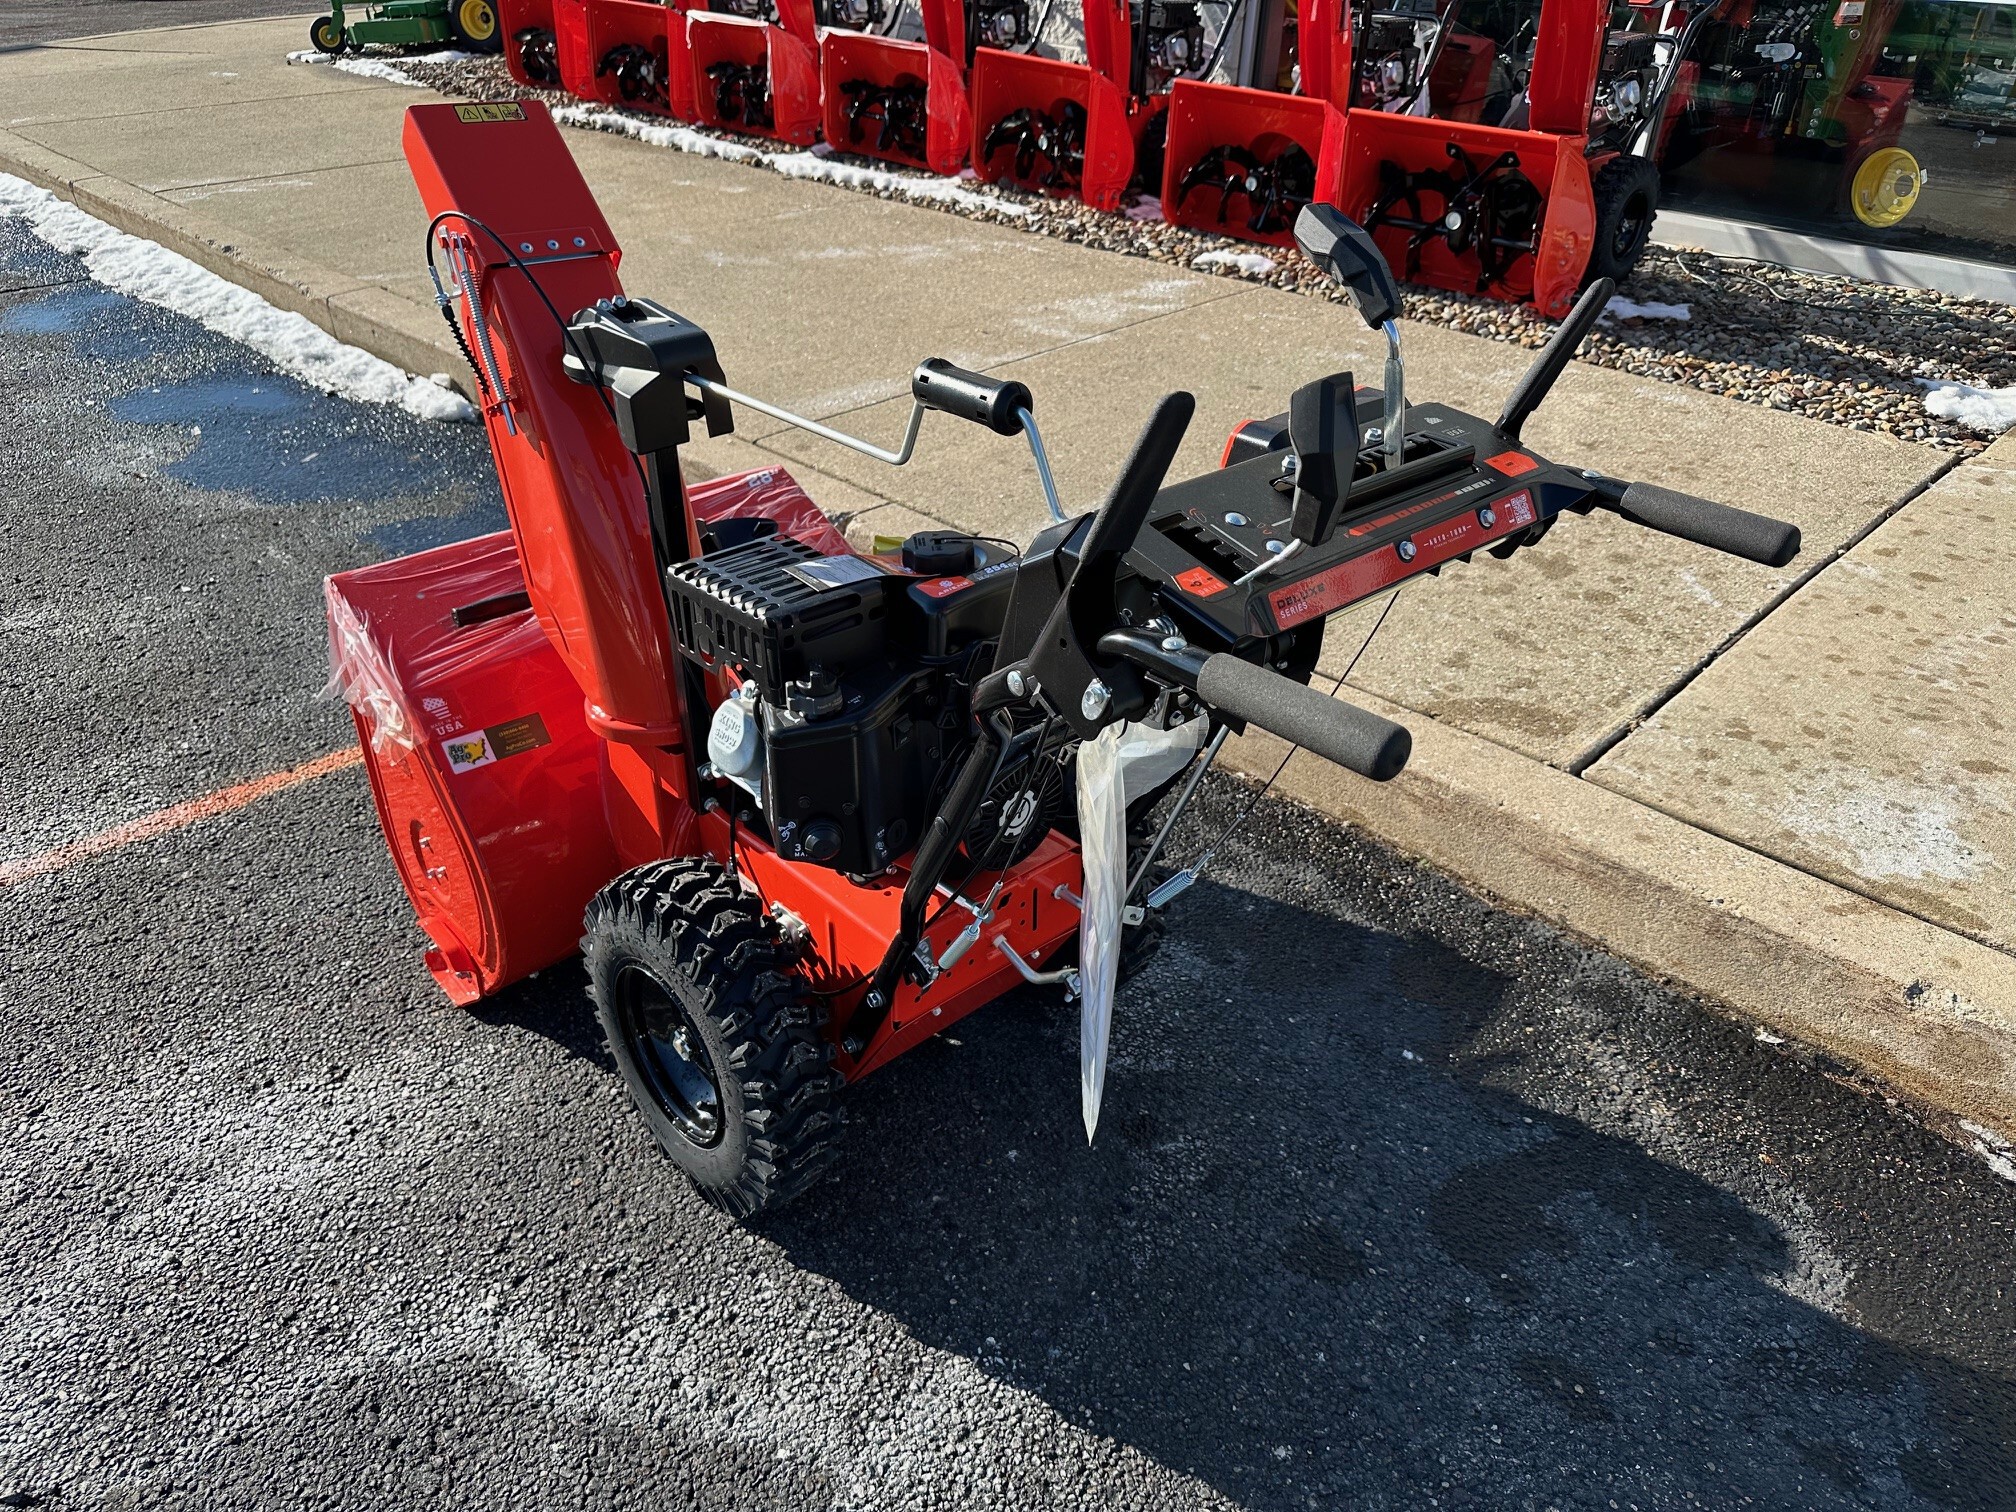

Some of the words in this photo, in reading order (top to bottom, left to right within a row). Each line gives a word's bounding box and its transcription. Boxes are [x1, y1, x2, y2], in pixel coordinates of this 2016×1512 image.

[938, 581, 970, 596] ARIENS
[1197, 582, 1223, 596] DRIVE
[1276, 582, 1325, 610] DELUXE
[1280, 602, 1309, 619] SERIES
[436, 720, 464, 736] USA
